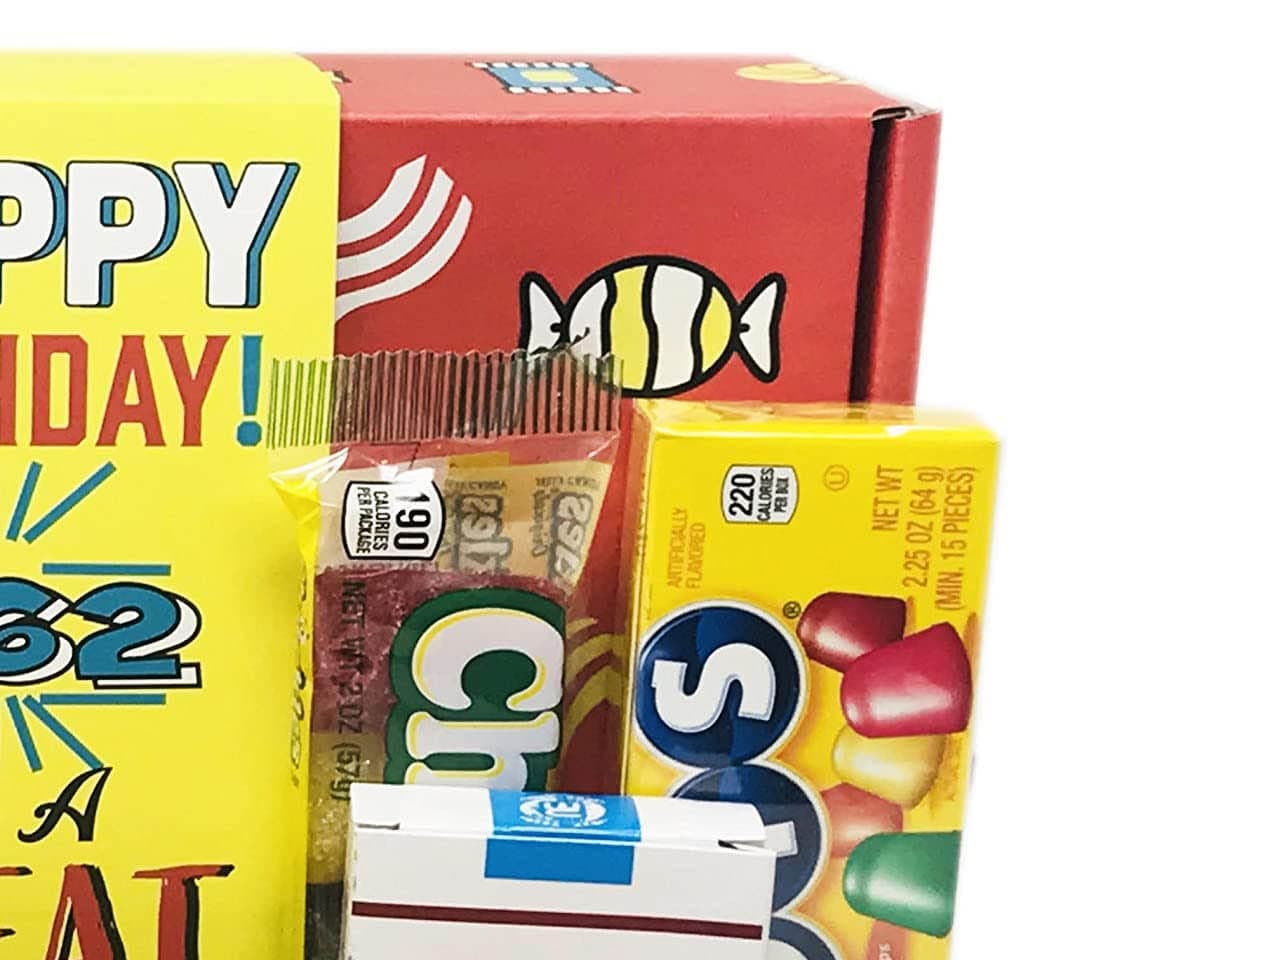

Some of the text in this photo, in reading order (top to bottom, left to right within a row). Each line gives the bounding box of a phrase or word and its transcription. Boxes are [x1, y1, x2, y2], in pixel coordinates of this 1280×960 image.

[372, 491, 389, 552] CALORIES
[393, 478, 432, 550] 190
[728, 472, 756, 517] 220
[757, 467, 775, 522] CALORIES
[774, 476, 789, 514] PER BOX
[872, 465, 904, 531] NET WT
[902, 466, 946, 587] 2.25 OZ (64 g)
[666, 508, 688, 588] ARTIFICIALLY
[685, 523, 705, 589] FLAVORED
[935, 466, 977, 612] (MIN. 15 PIECES)
[342, 579, 367, 630] NET
[337, 702, 365, 734] OZ
[18, 767, 113, 842] A
